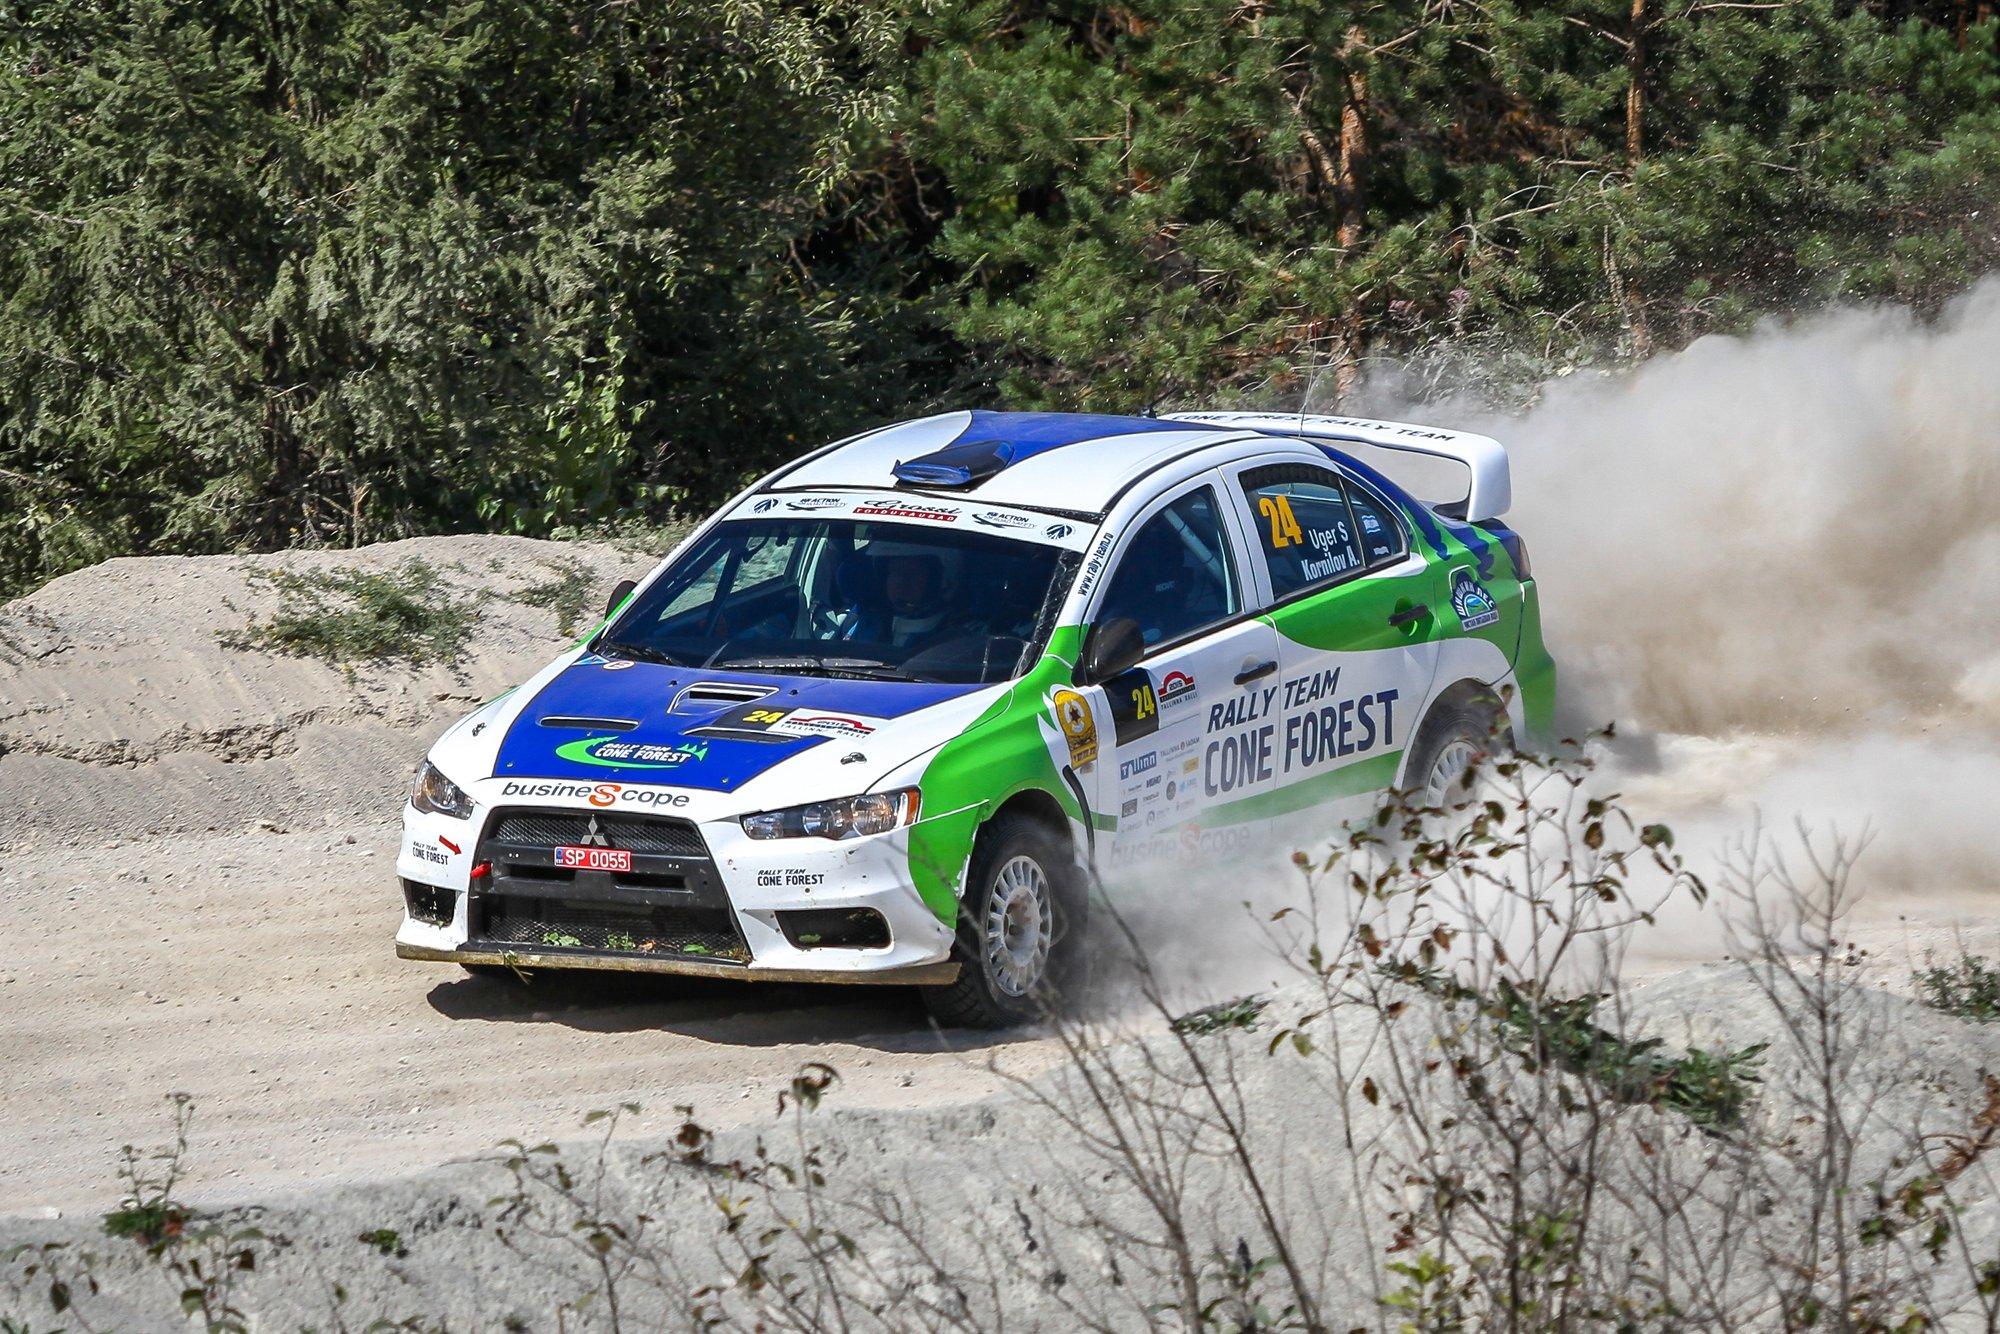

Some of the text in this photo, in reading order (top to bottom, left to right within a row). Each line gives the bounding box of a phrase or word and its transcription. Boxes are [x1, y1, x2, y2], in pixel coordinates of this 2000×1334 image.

[1320, 418, 1391, 431] RALLY
[1396, 428, 1456, 442] TEAM
[856, 508, 955, 521] TOIDUKAUBAD
[998, 513, 1030, 523] ACTION
[1258, 494, 1303, 549] 24
[1308, 520, 1349, 552] Uger S
[1301, 545, 1361, 581] Kornilov A.
[1132, 684, 1155, 720] 24
[1207, 685, 1278, 734] RALLY
[1283, 666, 1342, 711] TEAM
[742, 710, 785, 724] 24
[1204, 688, 1400, 798] CONE FOREST
[595, 748, 692, 763] CONE FOREST
[501, 781, 690, 808] busineScope
[412, 847, 448, 865] CONE FOREST
[565, 849, 627, 869] SP 0055
[757, 874, 825, 886] CONE FOREST
